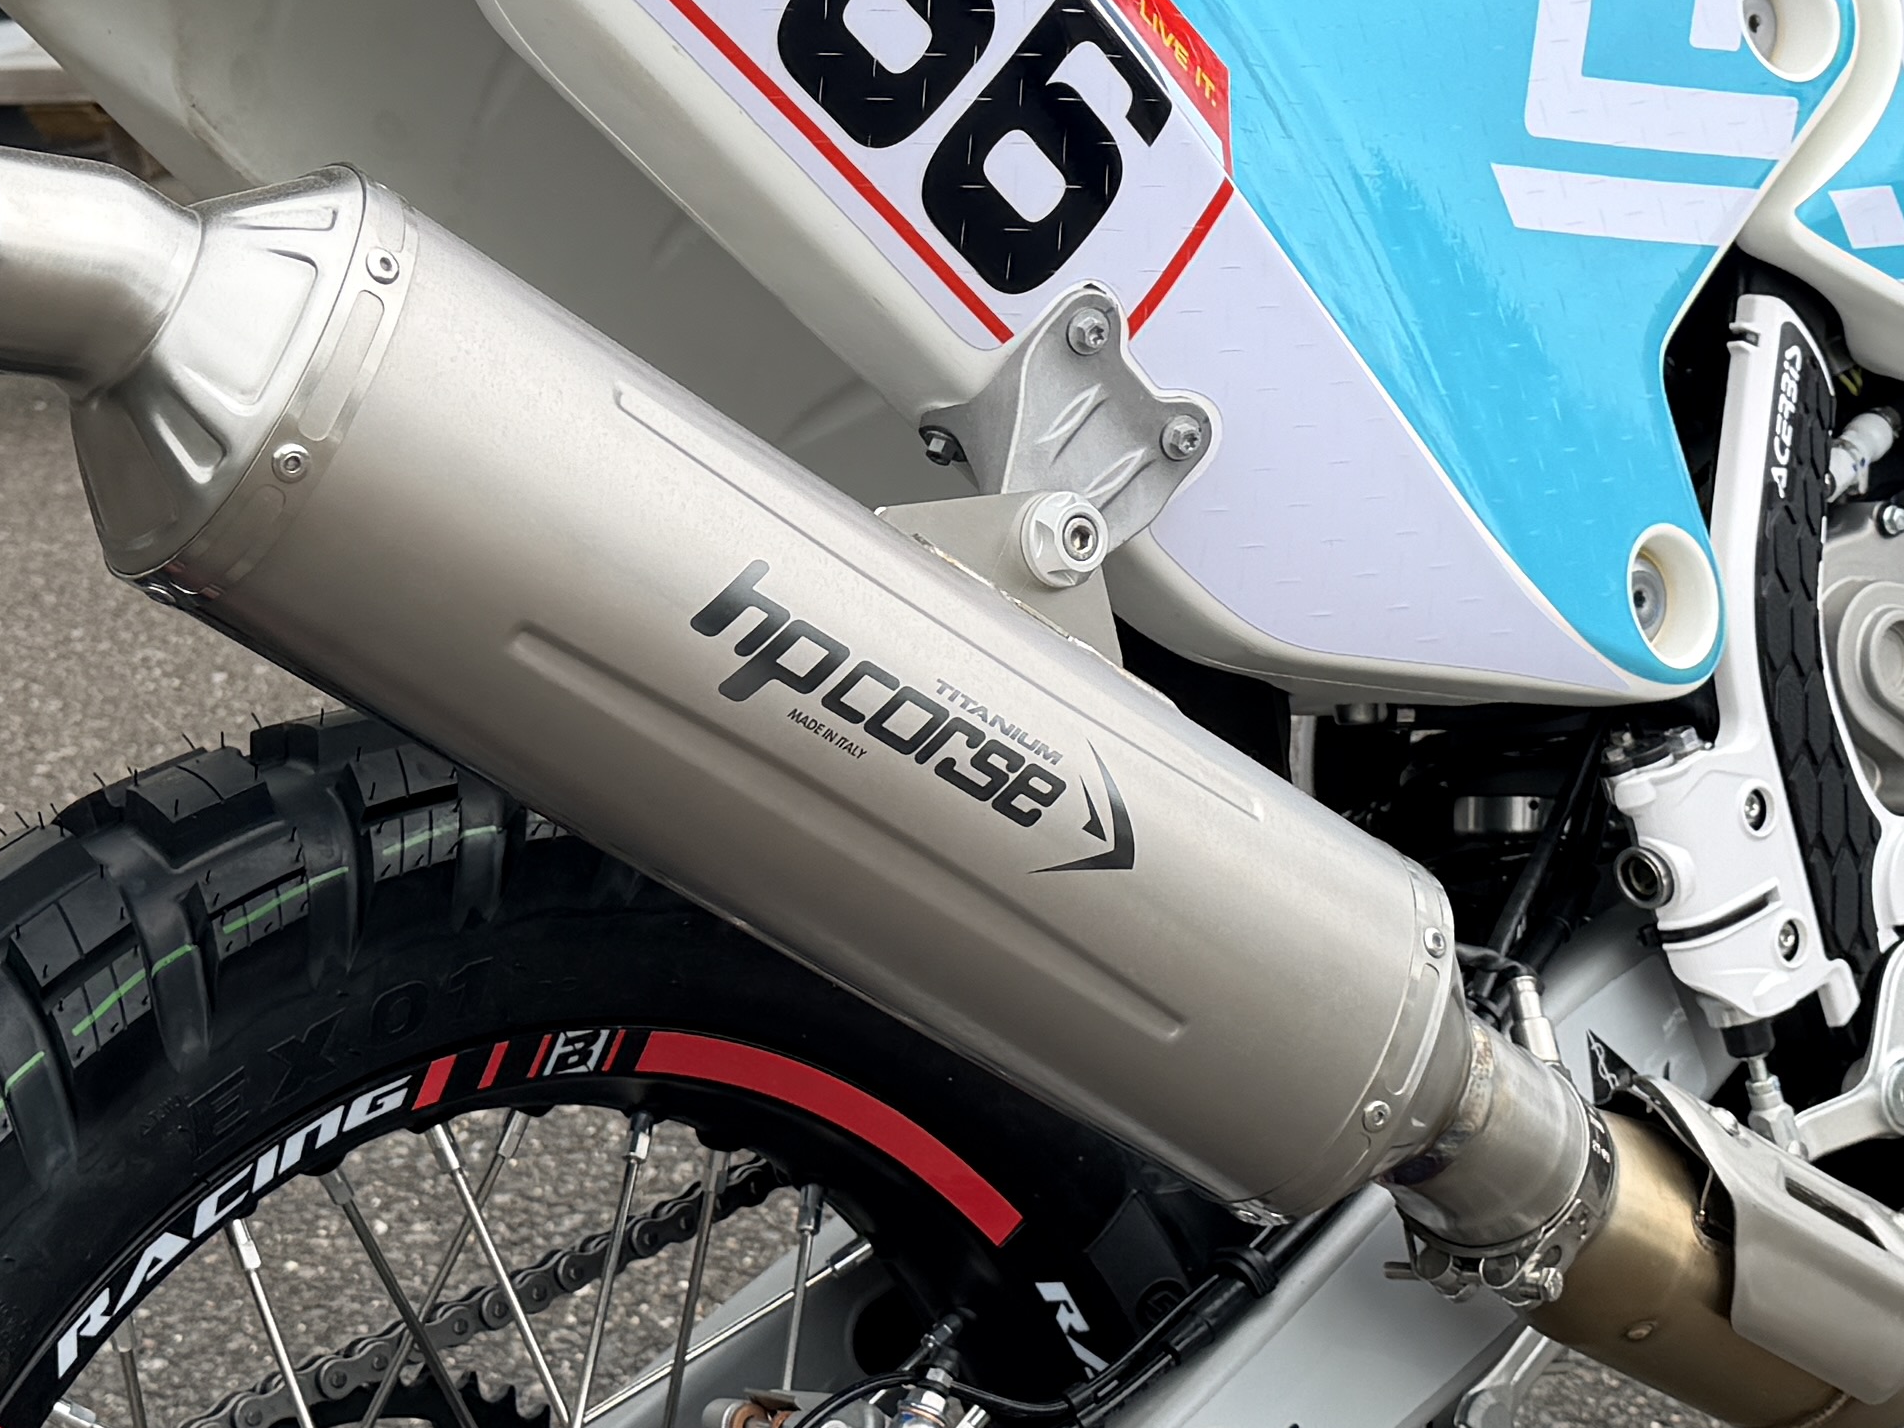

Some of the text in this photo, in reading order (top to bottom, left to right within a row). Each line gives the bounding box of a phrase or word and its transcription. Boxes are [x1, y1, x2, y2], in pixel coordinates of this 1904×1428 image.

[786, 707, 826, 738] MADE
[834, 736, 868, 760] ITALY
[936, 677, 1064, 767] TITANIUM
[57, 1074, 413, 1381] RACING
